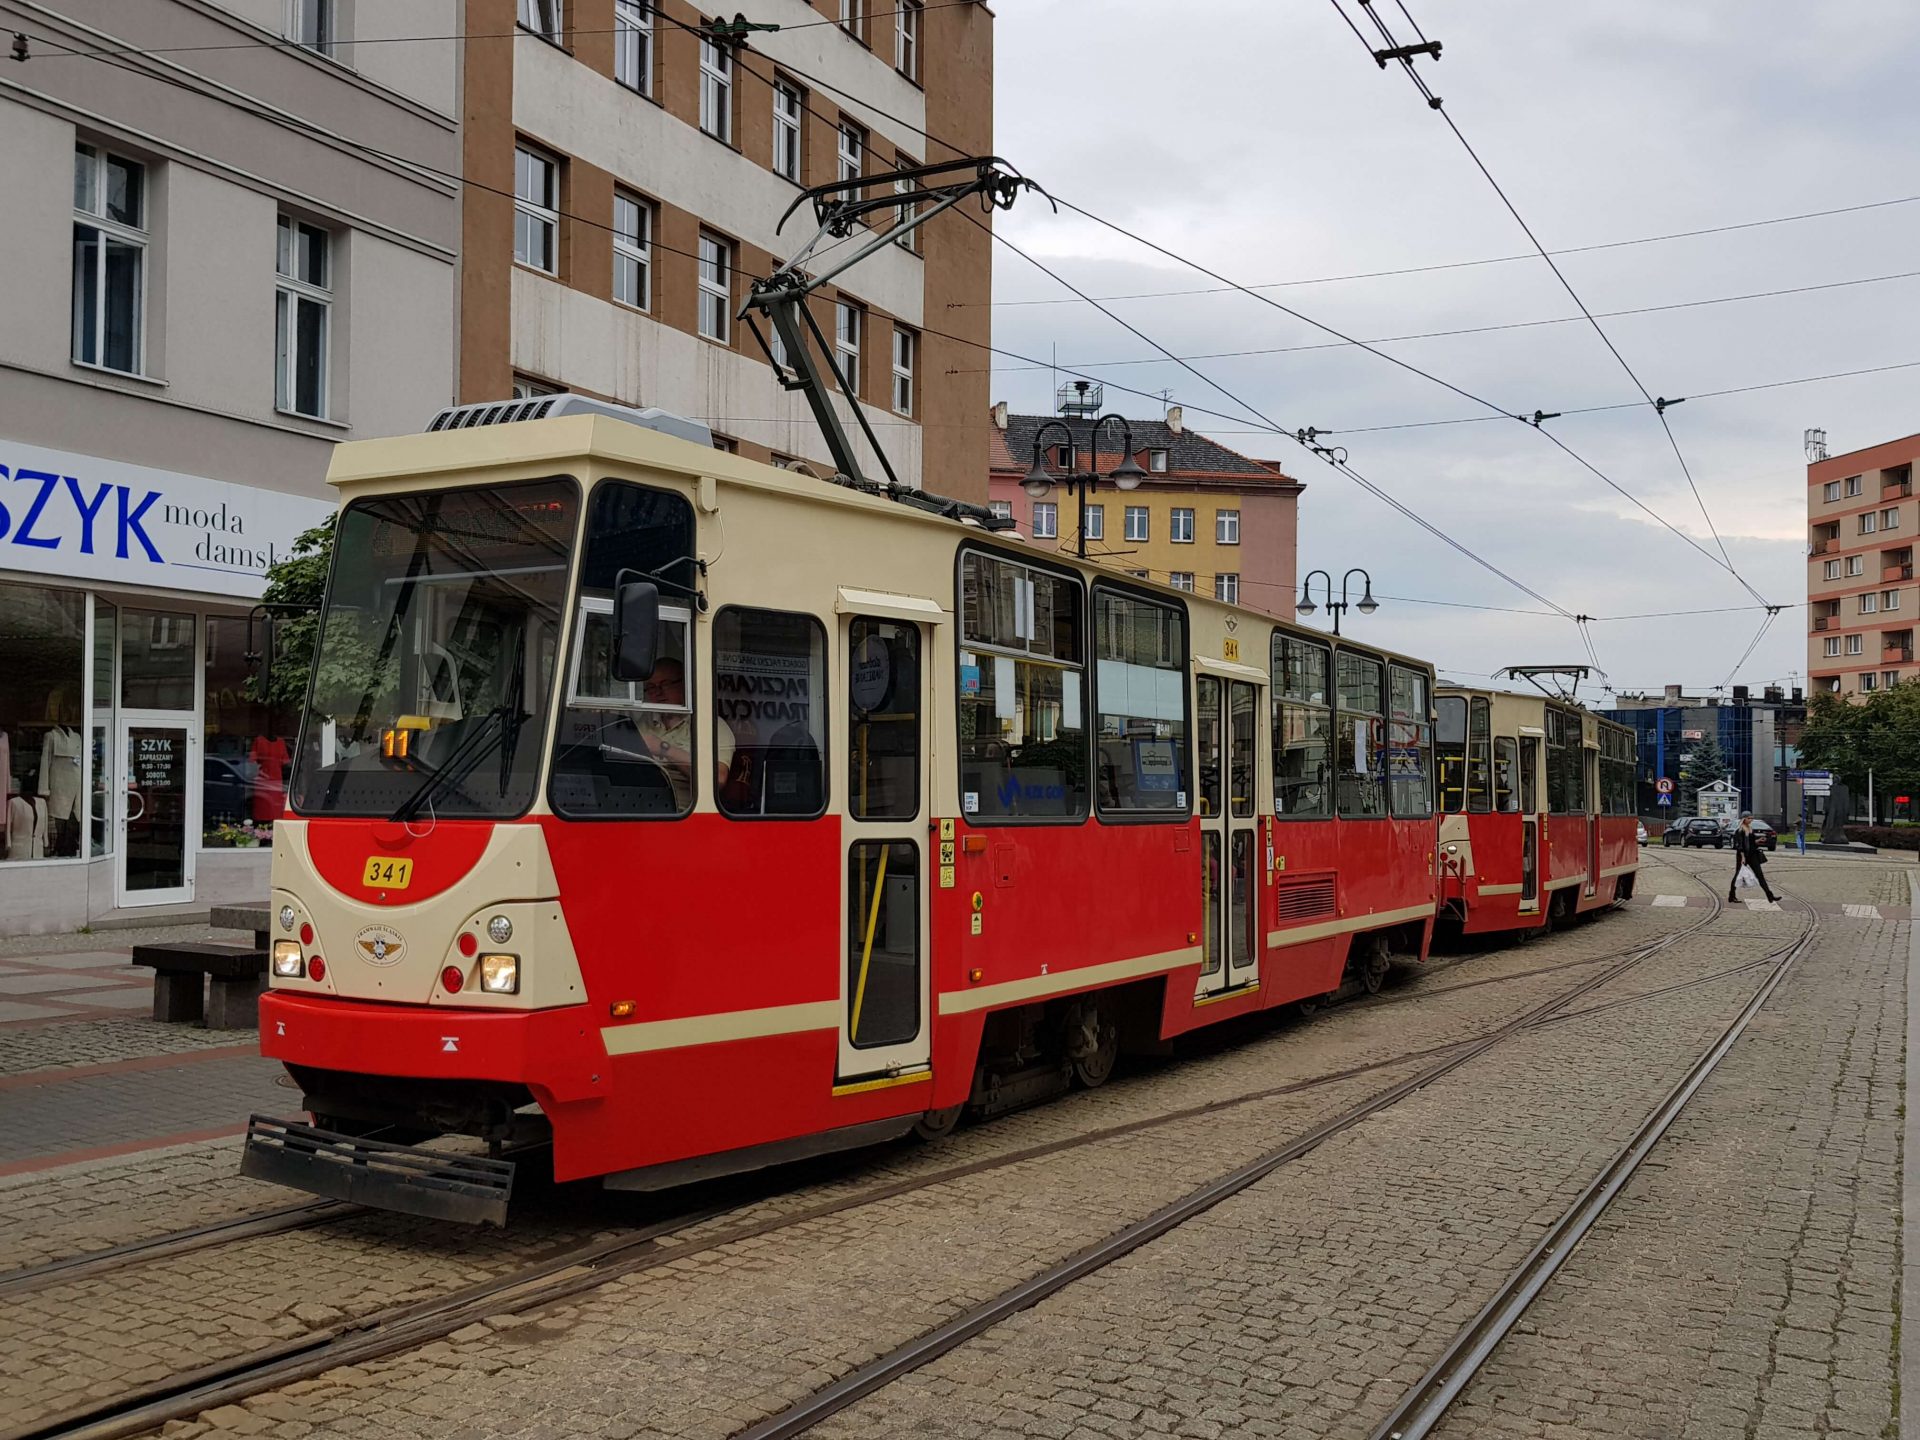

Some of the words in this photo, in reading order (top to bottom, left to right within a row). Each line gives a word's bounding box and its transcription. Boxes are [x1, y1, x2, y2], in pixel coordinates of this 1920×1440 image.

[163, 502, 245, 535] moda
[1225, 642, 1238, 658] 341
[141, 739, 172, 751] SZYK
[384, 730, 408, 757] 11
[370, 862, 406, 883] 341
